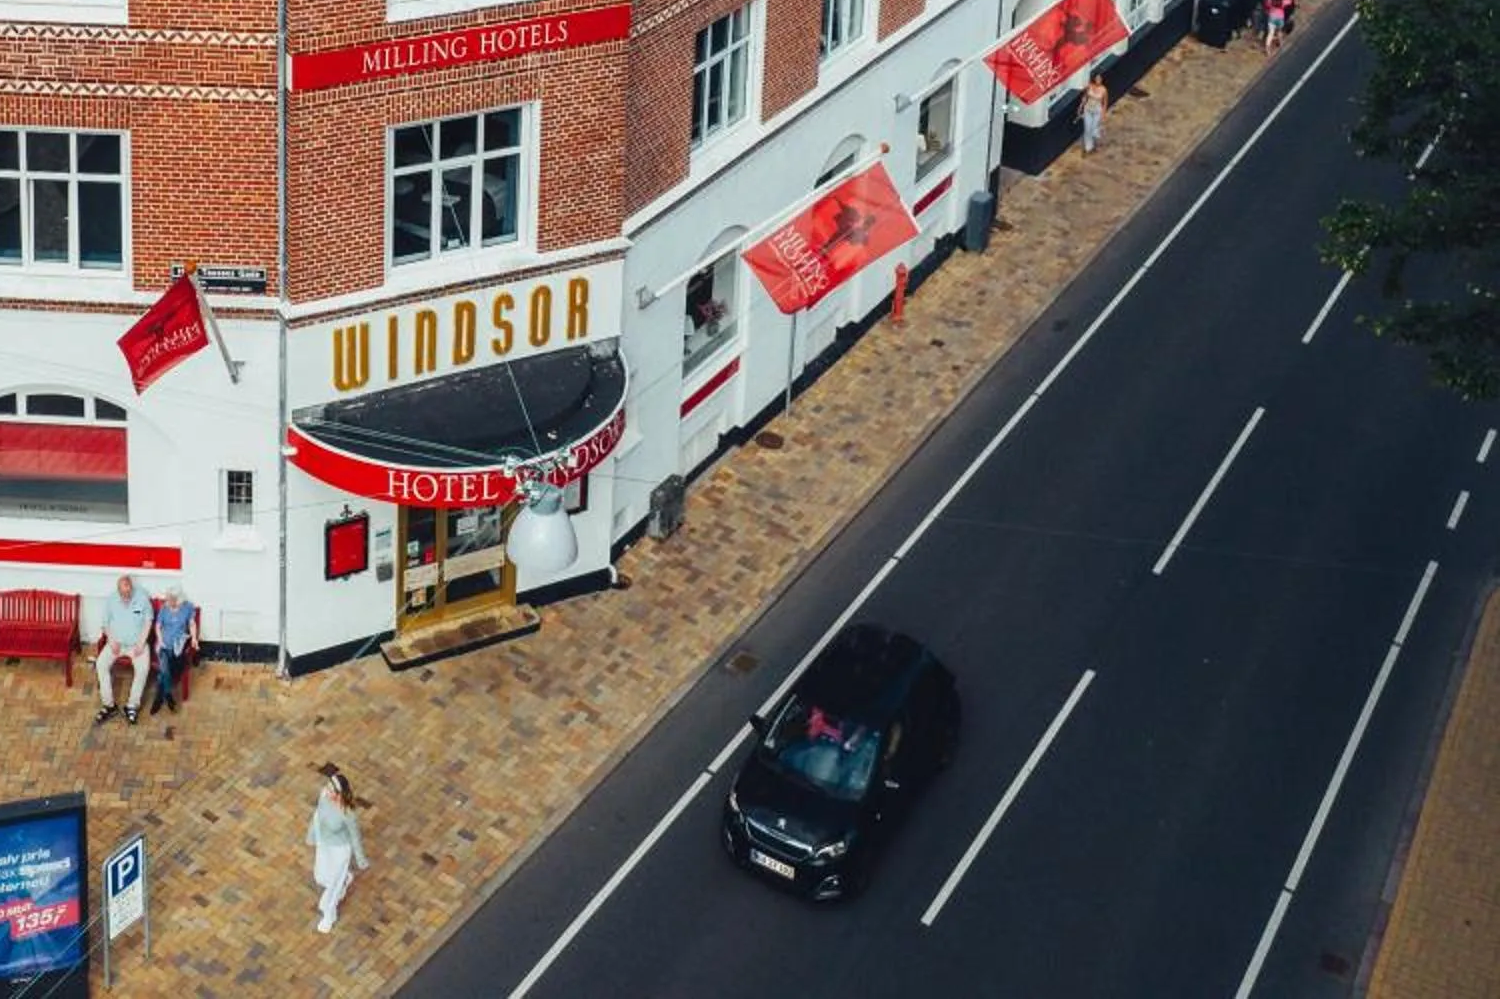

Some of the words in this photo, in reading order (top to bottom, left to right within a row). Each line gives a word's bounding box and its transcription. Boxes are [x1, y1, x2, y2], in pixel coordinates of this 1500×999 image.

[361, 35, 469, 74] MILLING
[479, 20, 569, 55] HOTELS
[333, 276, 589, 391] WINDSOR
[387, 469, 500, 503] HOTEL
[117, 854, 135, 890] P
